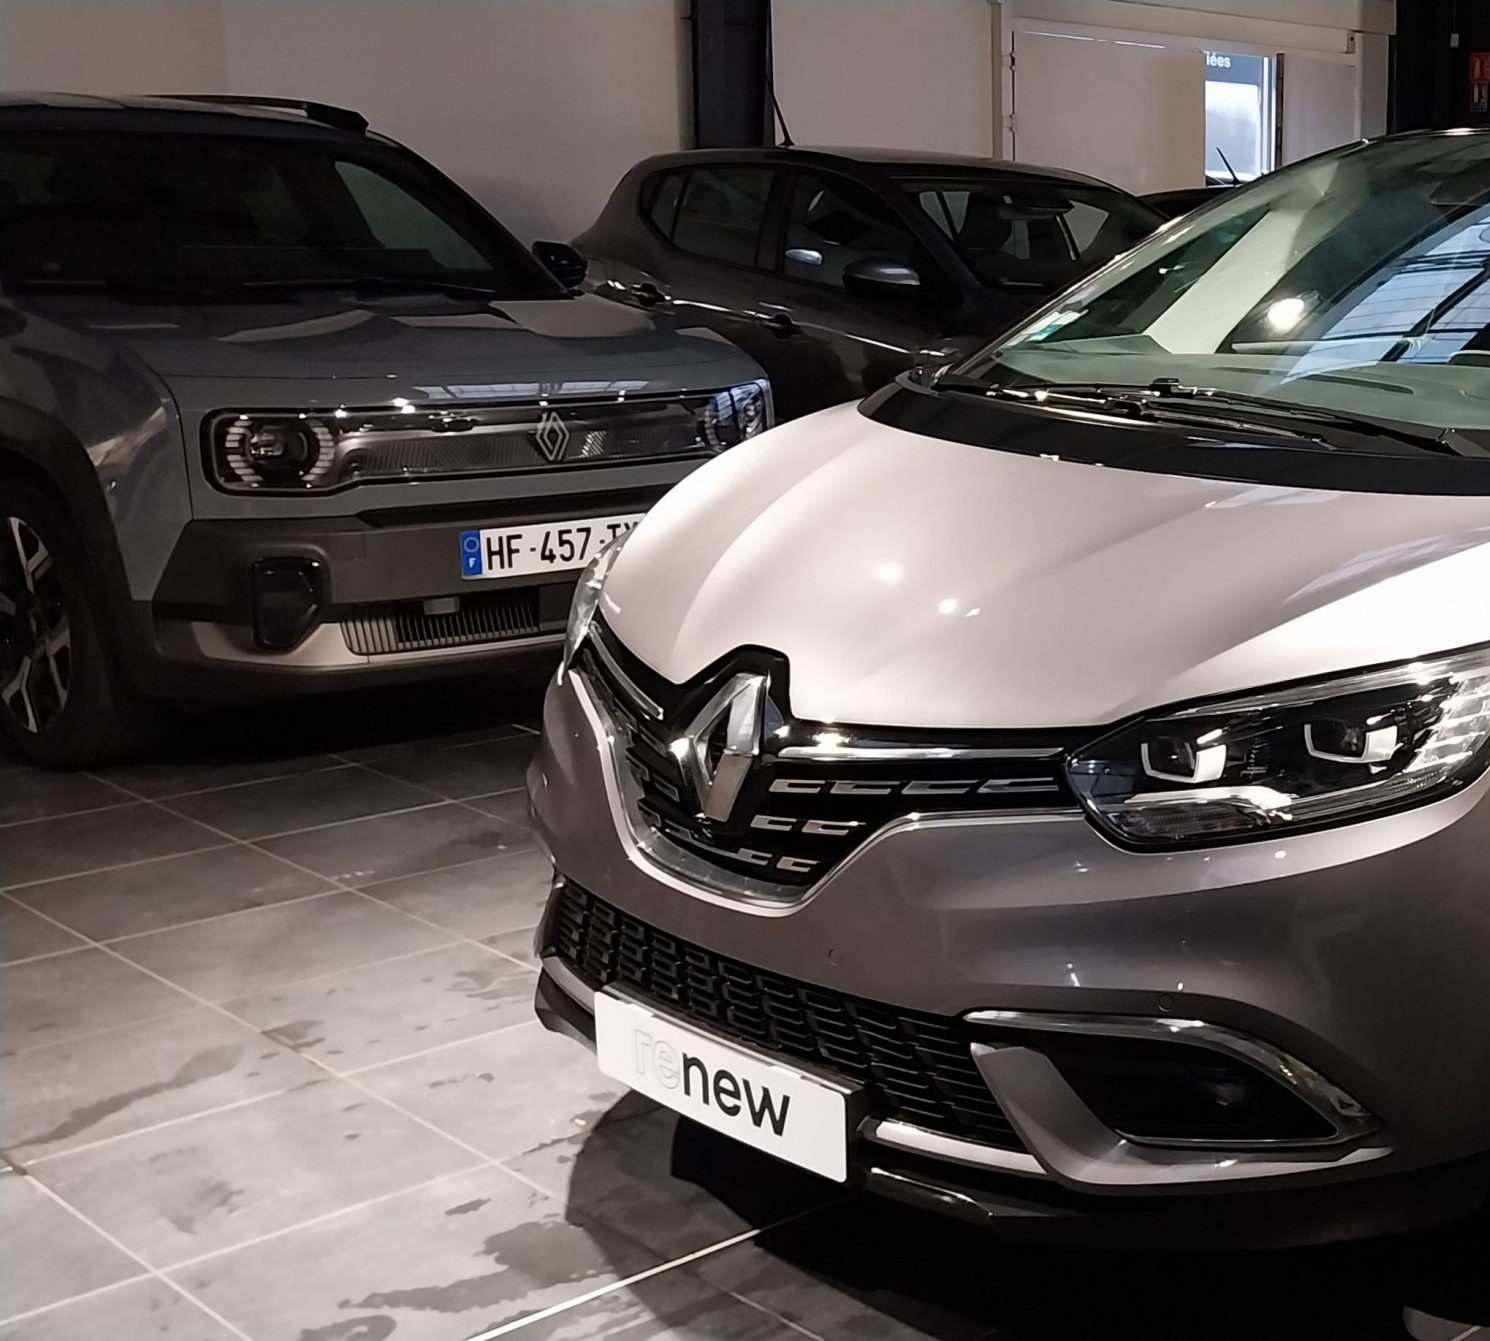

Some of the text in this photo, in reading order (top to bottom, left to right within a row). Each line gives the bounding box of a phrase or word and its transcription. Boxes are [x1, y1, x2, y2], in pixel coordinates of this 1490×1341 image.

[468, 557, 476, 569] F
[486, 521, 639, 570] HF-457-T
[634, 1028, 791, 1137] renew
